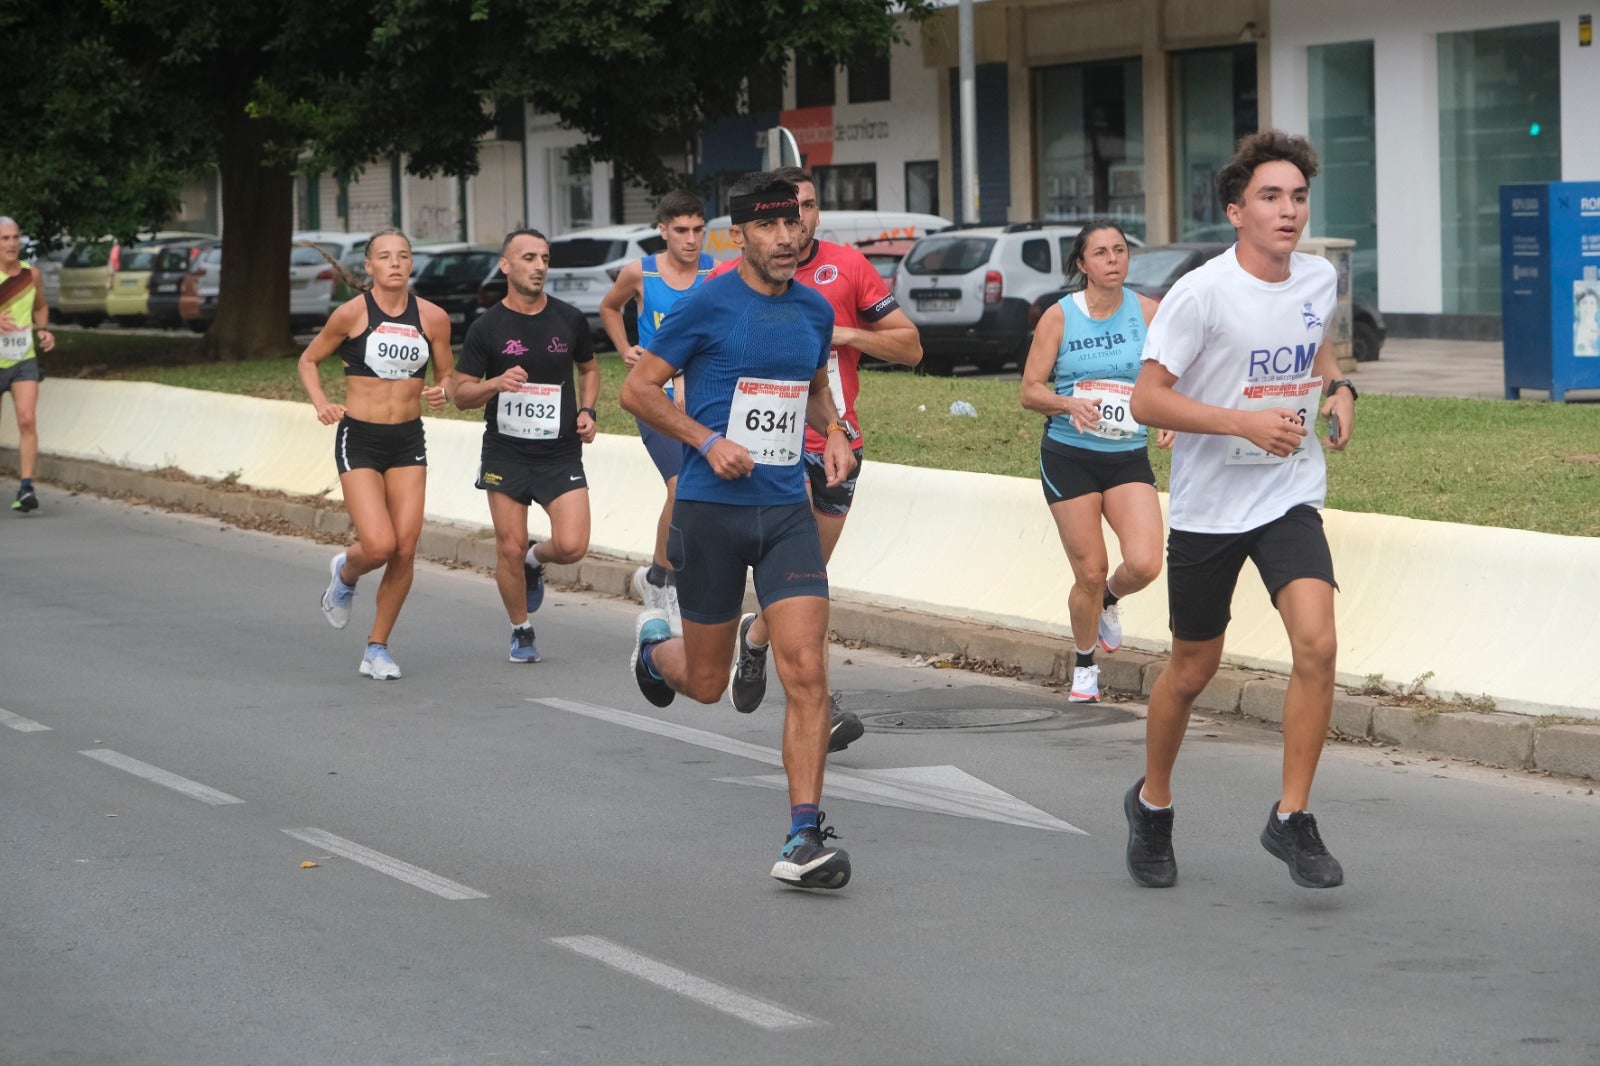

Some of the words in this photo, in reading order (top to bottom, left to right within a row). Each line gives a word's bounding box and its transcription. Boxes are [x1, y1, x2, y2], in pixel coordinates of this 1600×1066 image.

[1581, 197, 1600, 210] RO
[1068, 331, 1127, 352] nerja
[378, 342, 420, 361] 9008
[1078, 349, 1122, 361] ATLETISMO
[1249, 342, 1316, 377] RCM
[738, 381, 759, 396] 42
[1243, 386, 1264, 399] 42
[504, 401, 556, 420] 11632
[1098, 404, 1125, 422] 60
[745, 408, 797, 434] 6341
